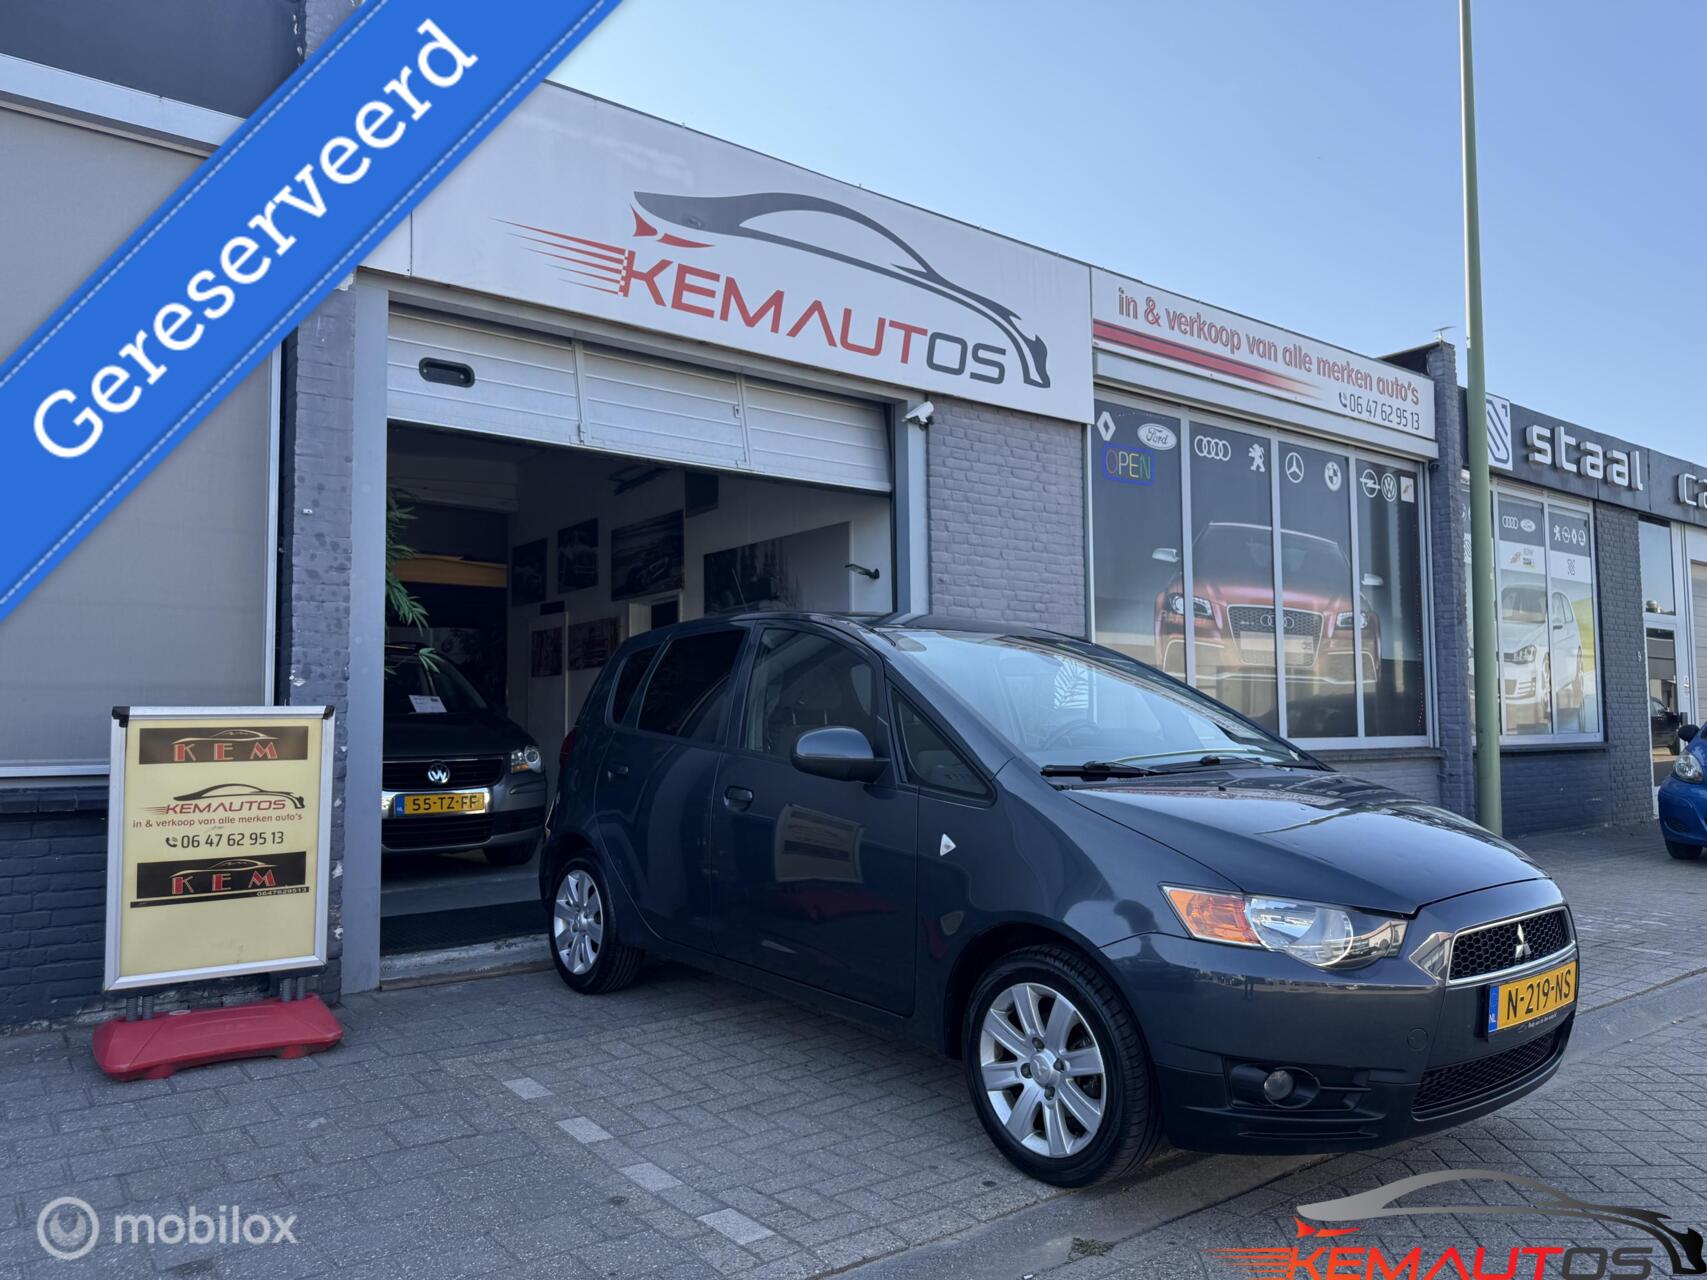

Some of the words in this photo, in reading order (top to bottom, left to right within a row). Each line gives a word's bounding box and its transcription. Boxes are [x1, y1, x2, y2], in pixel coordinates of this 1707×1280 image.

[619, 249, 1007, 384] KEMAUTOS
[1118, 287, 1138, 320] in
[1144, 296, 1161, 327] &
[1165, 307, 1242, 354] verkoop
[1246, 333, 1278, 363] van
[1283, 344, 1313, 372] alle
[1316, 356, 1373, 392] merken
[1376, 377, 1420, 405] auto's
[1348, 393, 1363, 413] 06
[1365, 399, 1378, 419] 47
[1380, 403, 1393, 422] 62
[1396, 407, 1408, 427] 95
[1410, 410, 1420, 431] 13
[1145, 427, 1168, 445] Ford
[1106, 448, 1151, 480] OPEN
[1526, 424, 1643, 491] staal
[165, 799, 286, 815] KEMAUTOS
[412, 795, 478, 811] 55-TZ-FF
[133, 820, 142, 829] in
[145, 819, 153, 827] &
[156, 818, 195, 829] verkoop
[198, 817, 216, 826] van
[218, 815, 236, 824] alle
[238, 814, 273, 824] merken
[275, 812, 303, 822] auto's
[181, 834, 200, 849] 06
[205, 833, 223, 847] 47
[227, 832, 244, 846] 62
[249, 831, 267, 845] 95
[271, 831, 285, 844] 13
[1507, 969, 1571, 1021] N-219-NS
